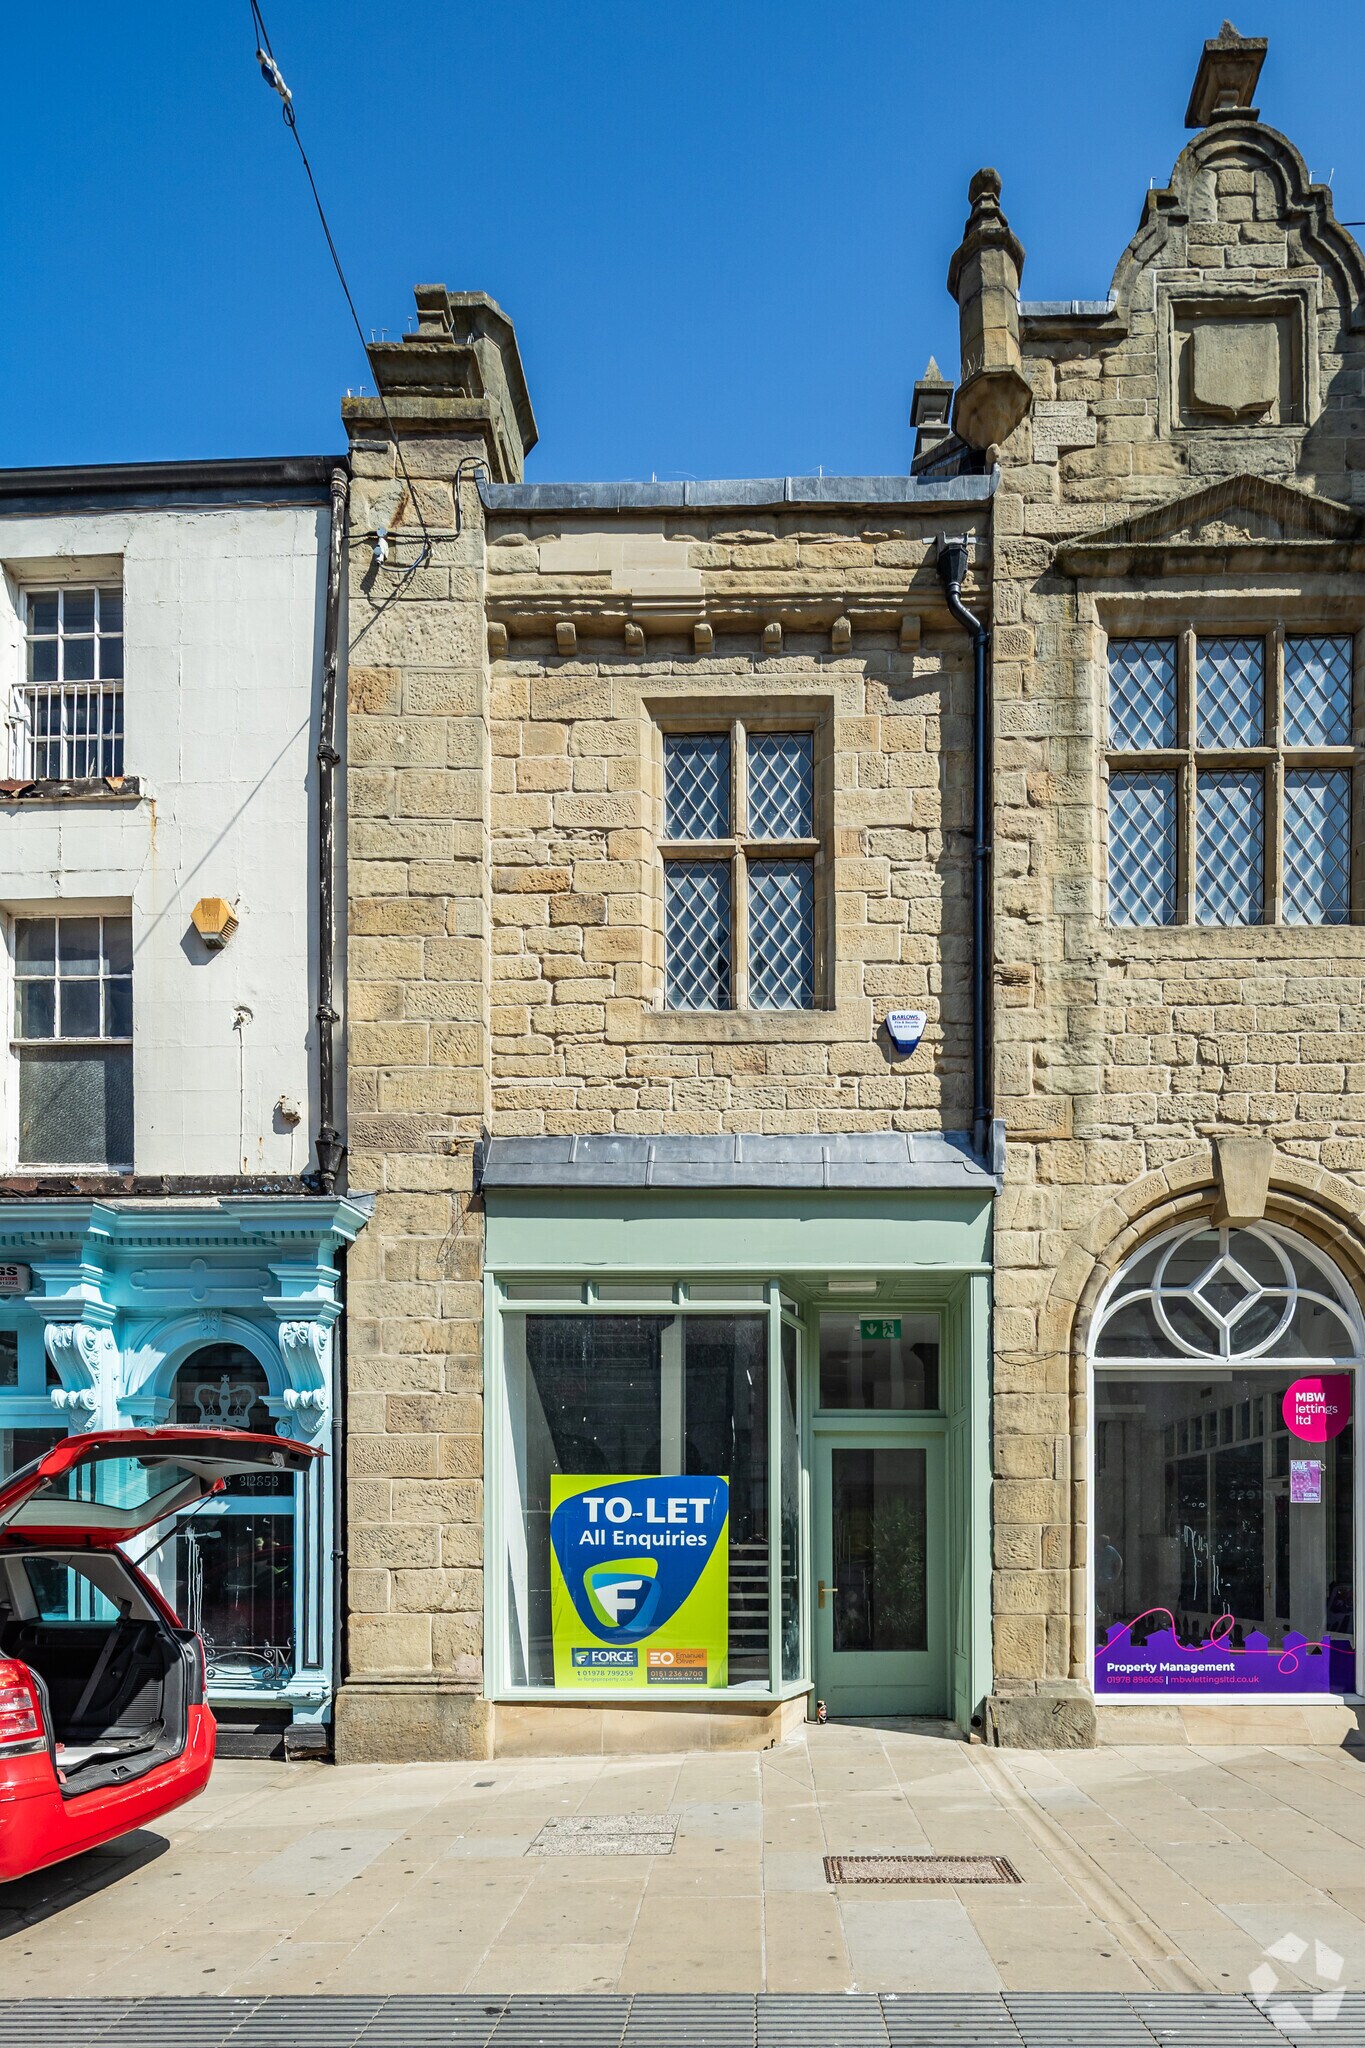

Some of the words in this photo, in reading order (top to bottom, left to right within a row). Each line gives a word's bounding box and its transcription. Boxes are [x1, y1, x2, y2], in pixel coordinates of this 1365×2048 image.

[1295, 1392, 1326, 1402] MBW
[1295, 1403, 1338, 1415] lettings
[579, 1529, 606, 1545] All
[612, 1530, 708, 1550] Enquiries
[591, 1651, 634, 1662] FORGE
[1106, 1662, 1157, 1673] Property
[1159, 1662, 1235, 1673] Management
[1106, 1676, 1131, 1684] 01978
[1132, 1676, 1164, 1684] 896065
[1170, 1675, 1260, 1684] mbwlettingsltd.co.uk
